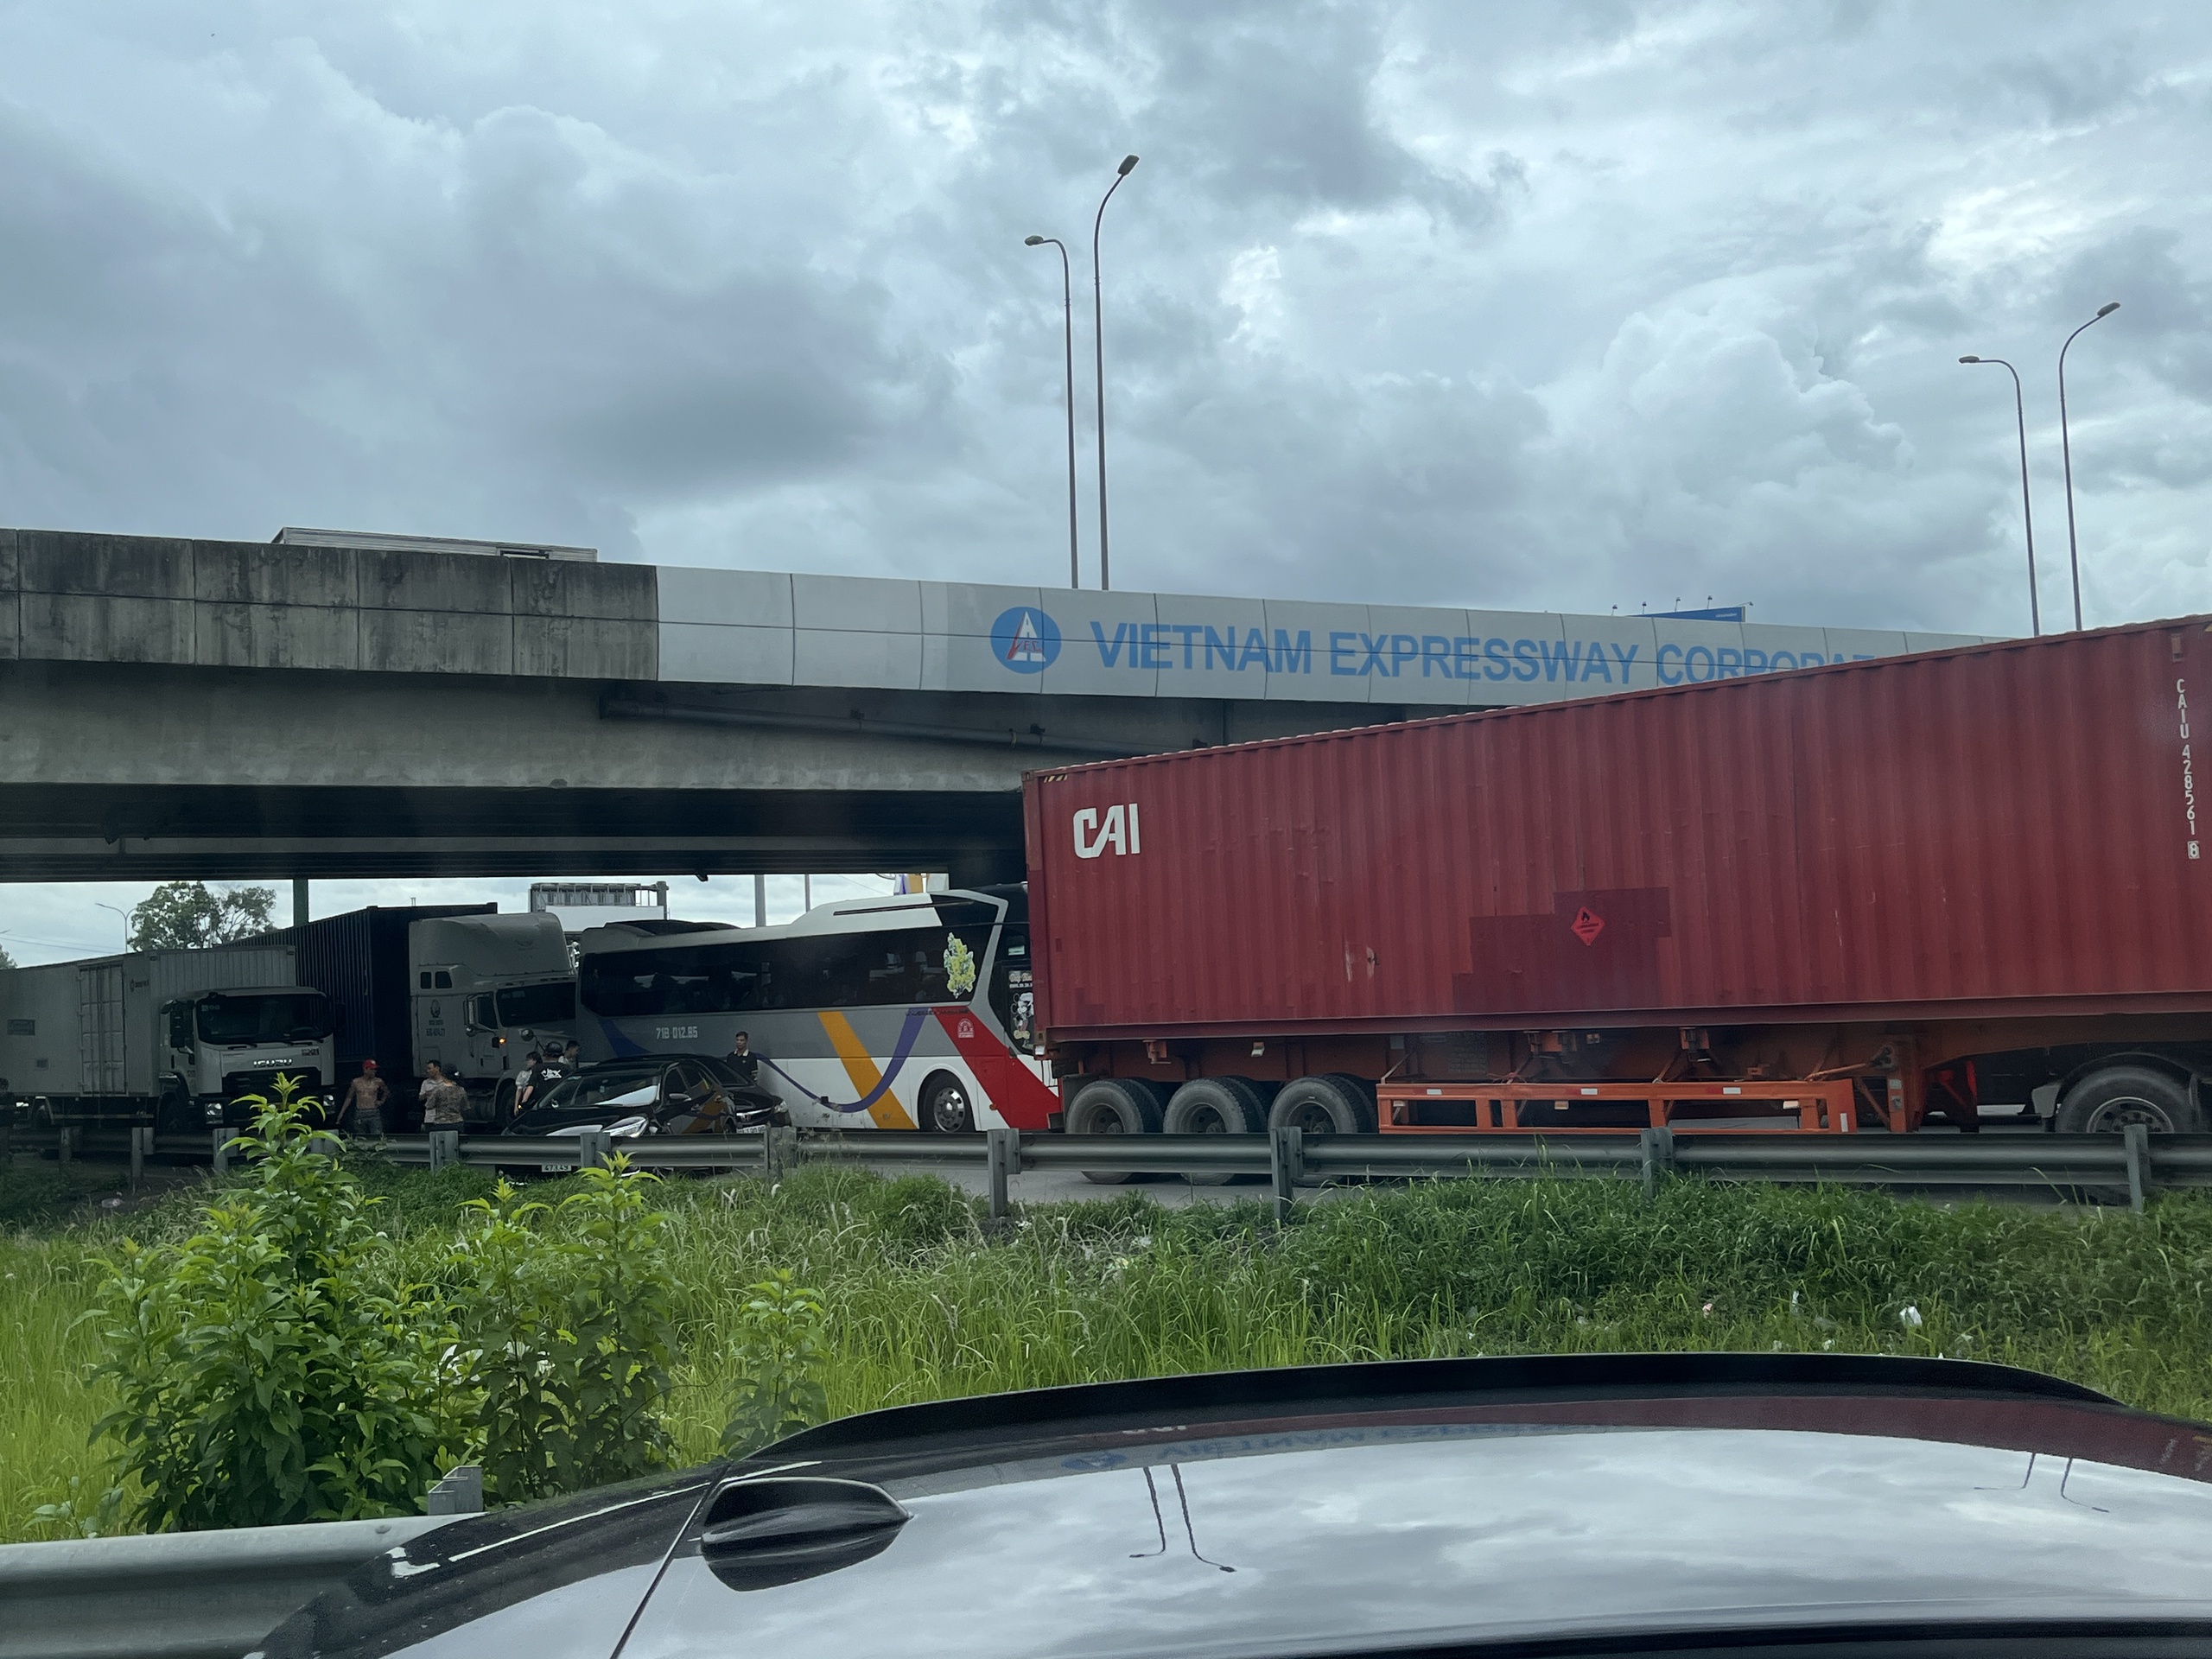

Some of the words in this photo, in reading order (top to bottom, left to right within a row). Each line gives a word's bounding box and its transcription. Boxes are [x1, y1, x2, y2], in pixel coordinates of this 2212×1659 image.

[1090, 620, 1312, 674] VIETNAM
[1329, 632, 1639, 684] EXPRESSWAY
[1658, 643, 1876, 685] CORPO
[2176, 678, 2190, 740] CAIU
[2182, 744, 2196, 836] 428561
[1073, 803, 1141, 859] CAI
[2188, 841, 2200, 859] 8
[253, 1058, 293, 1068] ISUZU
